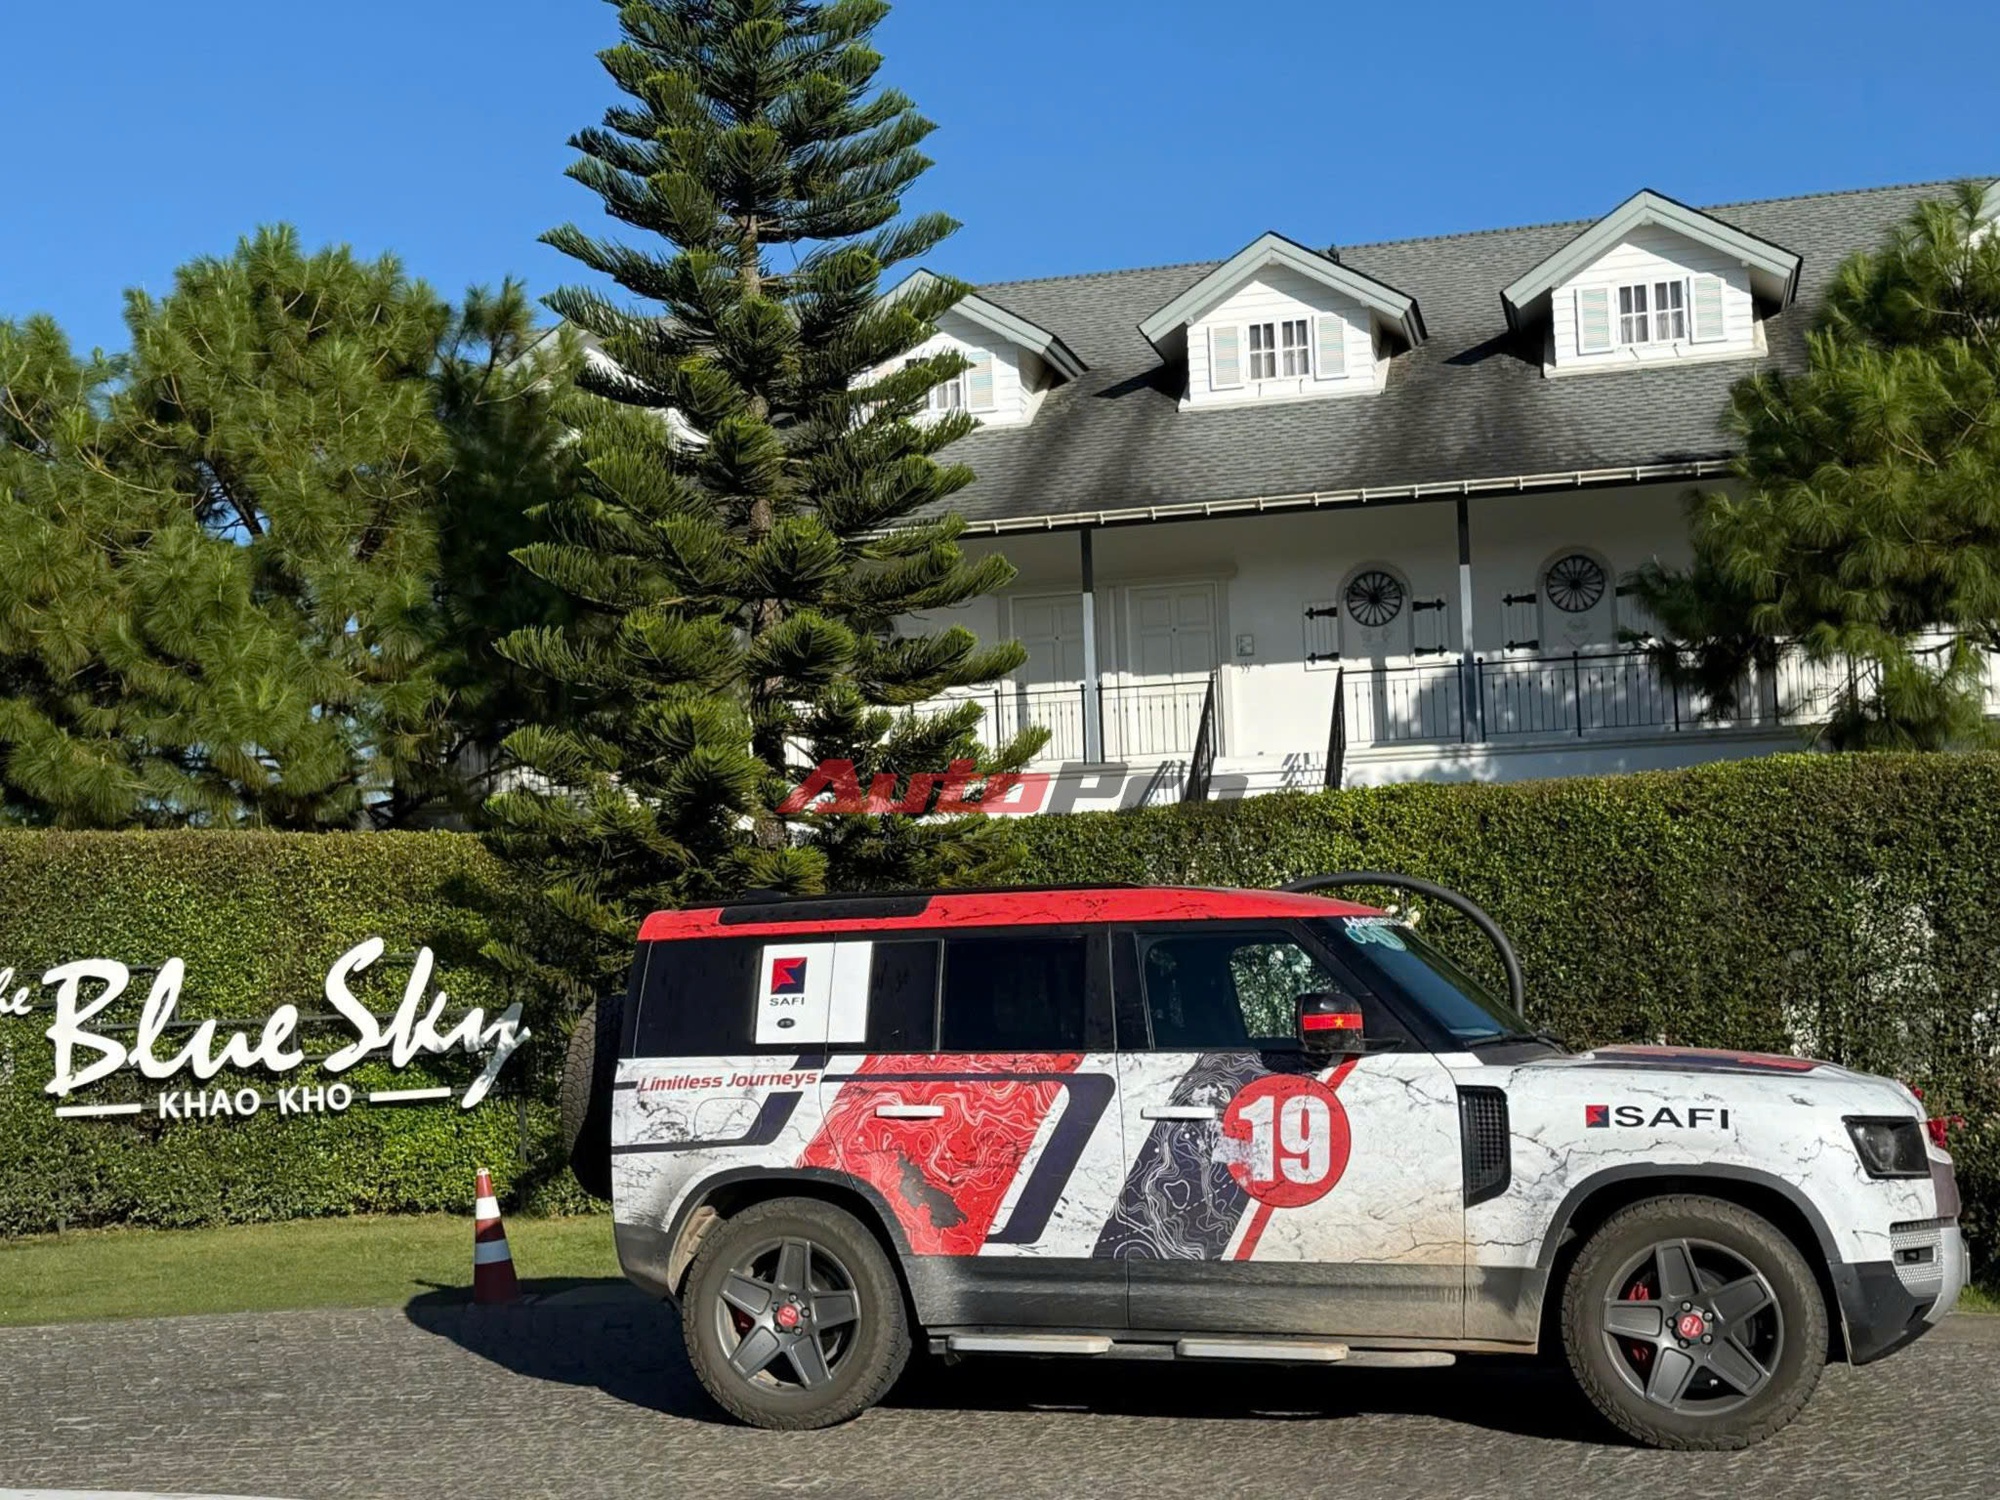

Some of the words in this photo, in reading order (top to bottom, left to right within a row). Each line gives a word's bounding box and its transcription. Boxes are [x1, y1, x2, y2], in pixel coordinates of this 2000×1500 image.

[769, 996, 805, 1007] SAFI
[42, 958, 305, 1097] Blue
[323, 936, 532, 1109] Sky
[640, 1075, 722, 1092] Limitless
[726, 1072, 818, 1089] Journeys
[159, 1088, 261, 1119] KHAO
[278, 1083, 352, 1115] KHO
[1614, 1105, 1730, 1130] SAFI
[1238, 1094, 1331, 1185] 19
